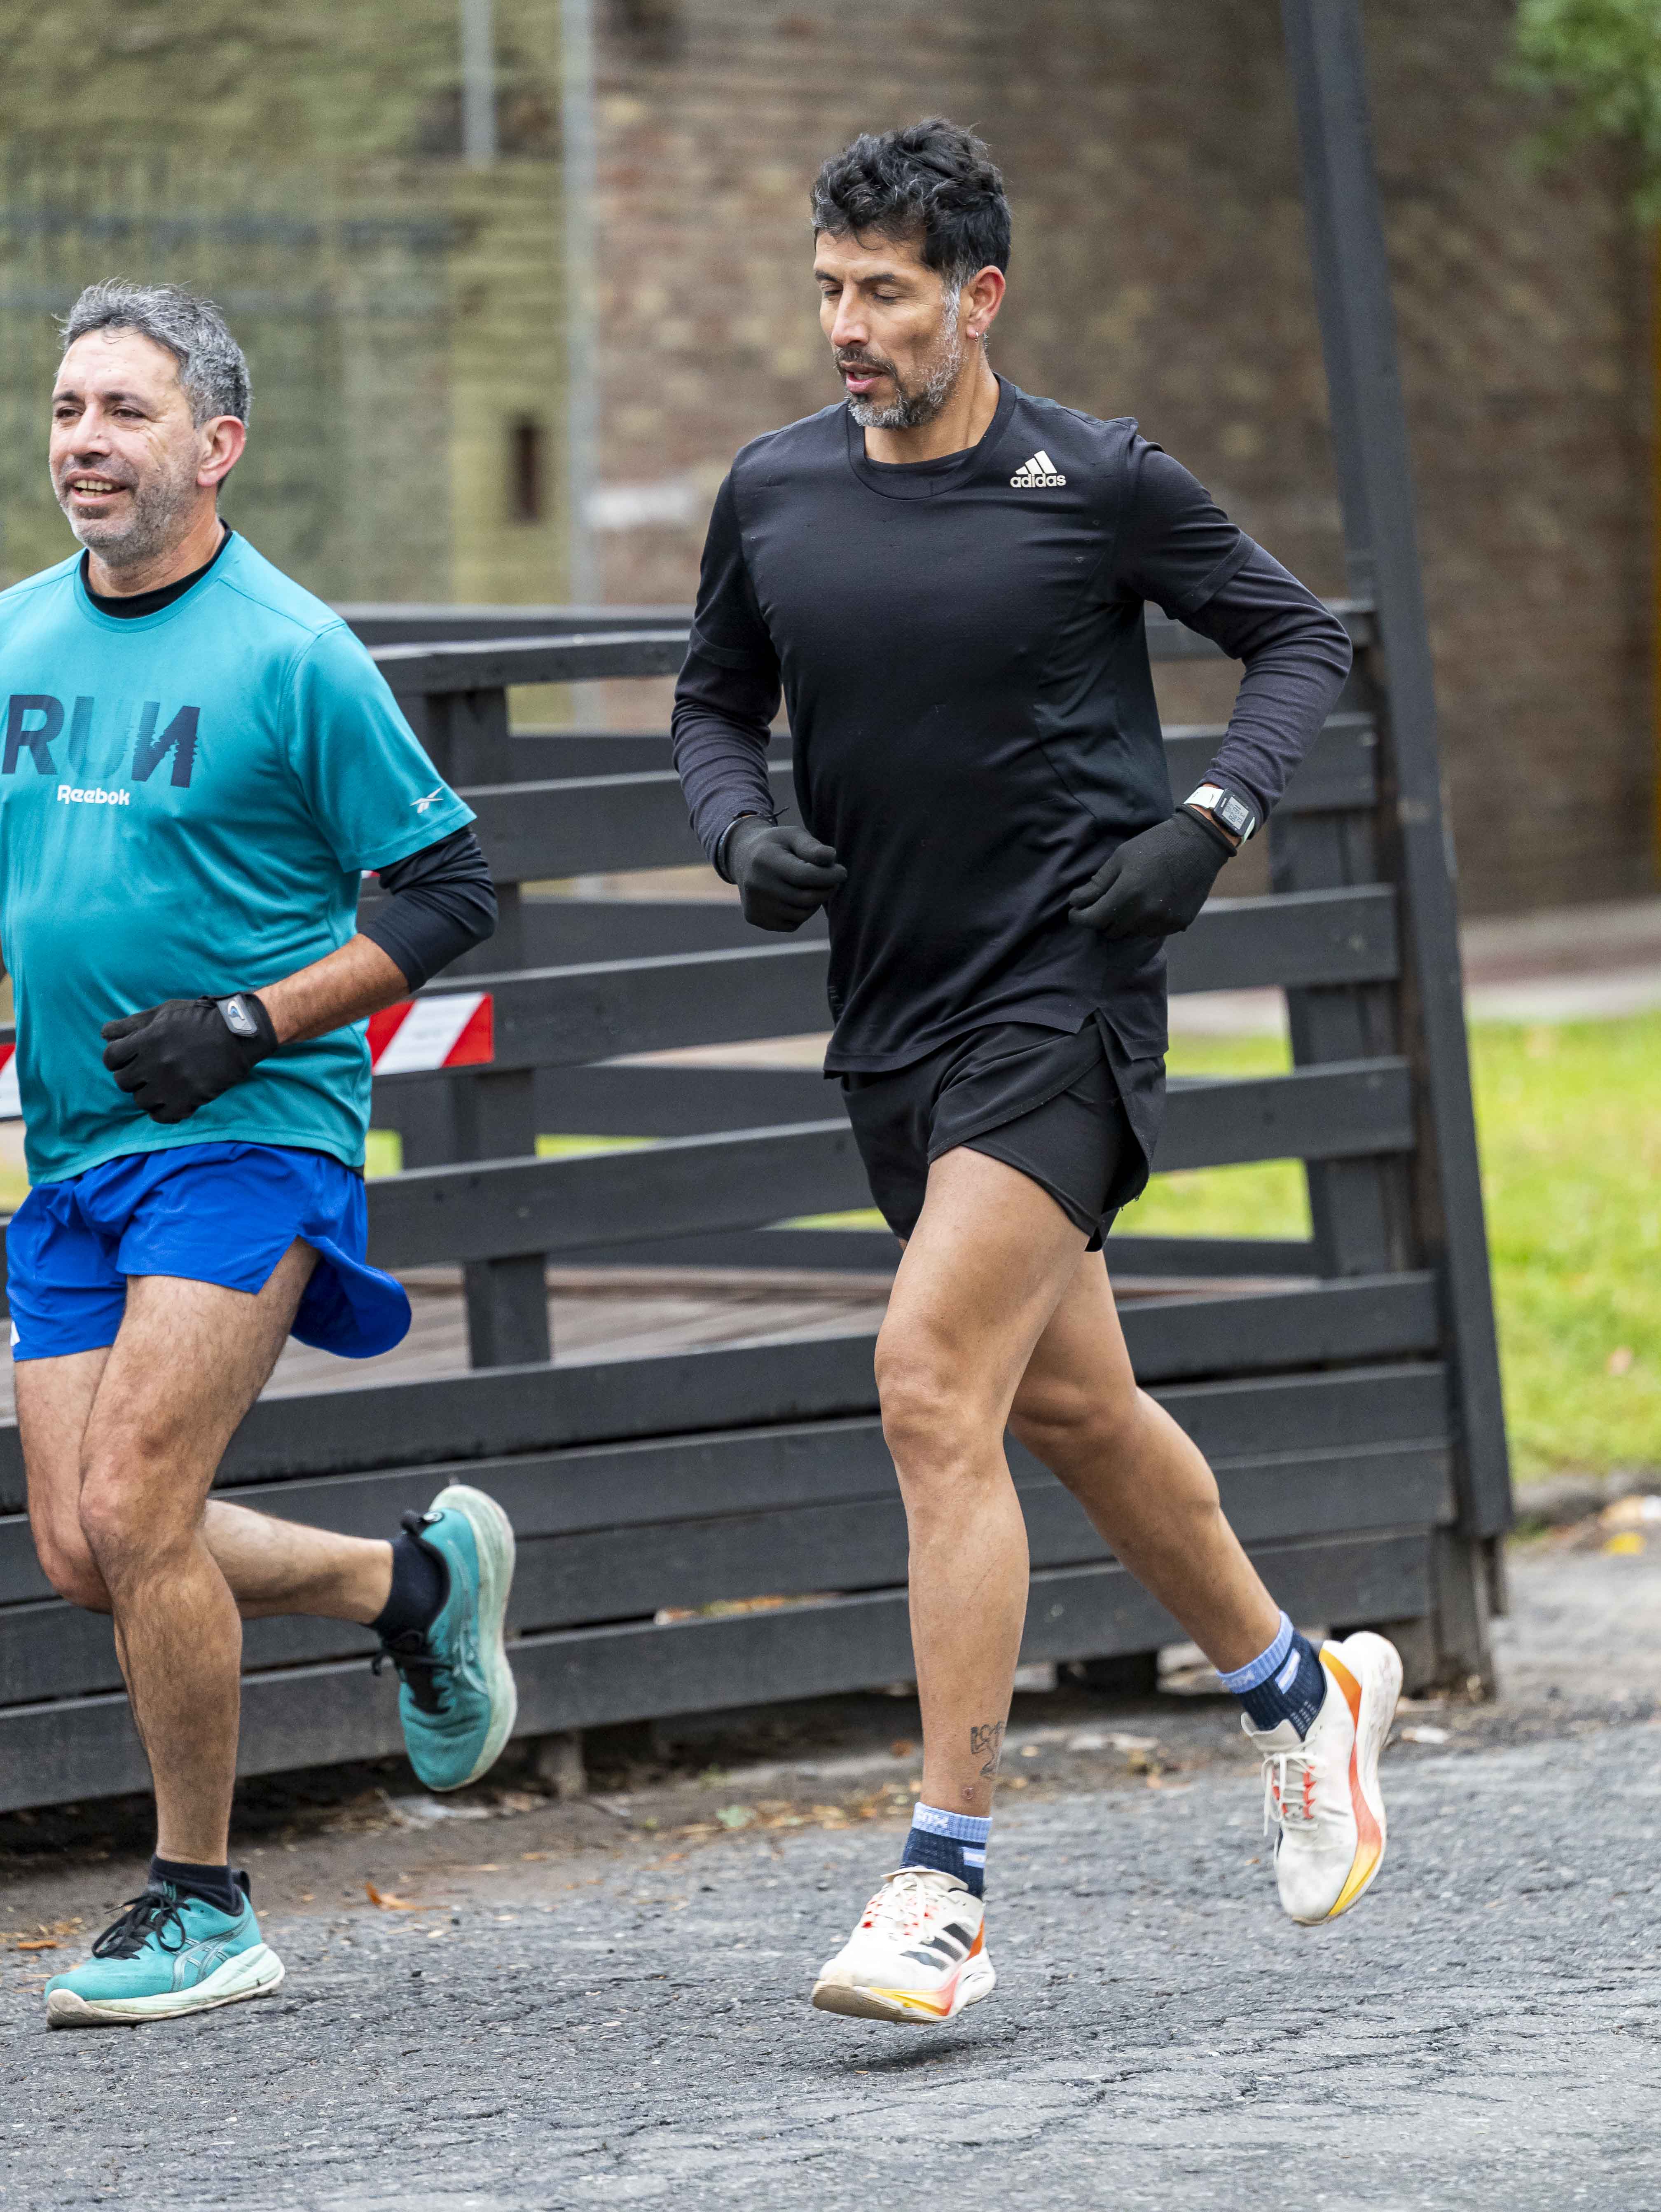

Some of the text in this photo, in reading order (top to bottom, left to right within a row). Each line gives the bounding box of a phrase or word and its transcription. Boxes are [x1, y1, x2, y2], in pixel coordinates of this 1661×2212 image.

[1010, 473, 1067, 488] adidas
[2, 694, 201, 789] RUN
[57, 784, 130, 805] Reebok
